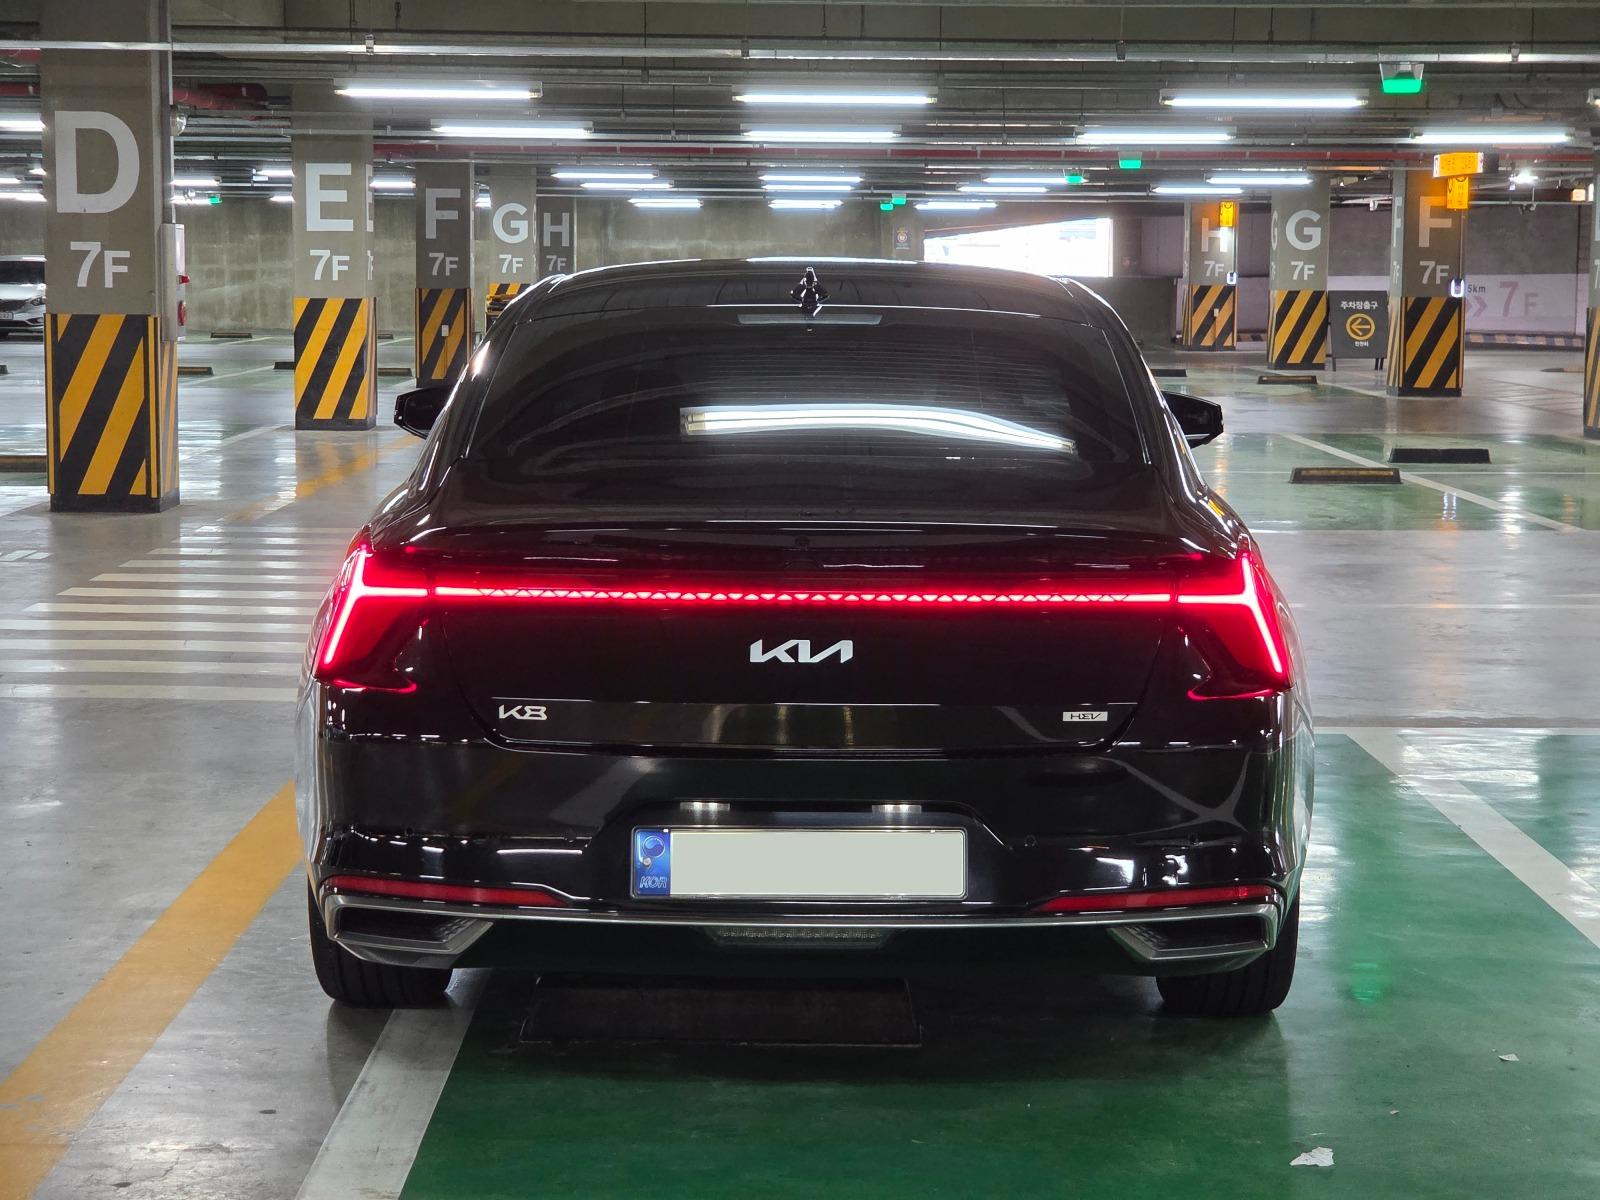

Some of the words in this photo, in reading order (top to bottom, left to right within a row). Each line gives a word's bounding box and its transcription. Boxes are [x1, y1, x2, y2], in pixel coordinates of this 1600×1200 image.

[55, 110, 140, 214] D
[305, 163, 353, 232] E
[425, 187, 461, 240] F
[492, 202, 529, 244] G
[1418, 196, 1453, 248] F
[543, 212, 570, 247] H
[1201, 217, 1229, 252] H
[1285, 209, 1322, 250] G
[70, 241, 131, 288] 7F
[309, 249, 350, 281] 7F
[428, 252, 459, 276] 7F
[498, 253, 524, 274] 7F
[546, 254, 567, 272] 7F
[1203, 260, 1225, 277] 7F
[1290, 261, 1316, 281] 7F
[1419, 260, 1450, 285] 7F
[749, 639, 853, 663] KIA
[498, 704, 548, 720] K8
[1070, 712, 1102, 720] HEV
[640, 876, 667, 888] KOR
